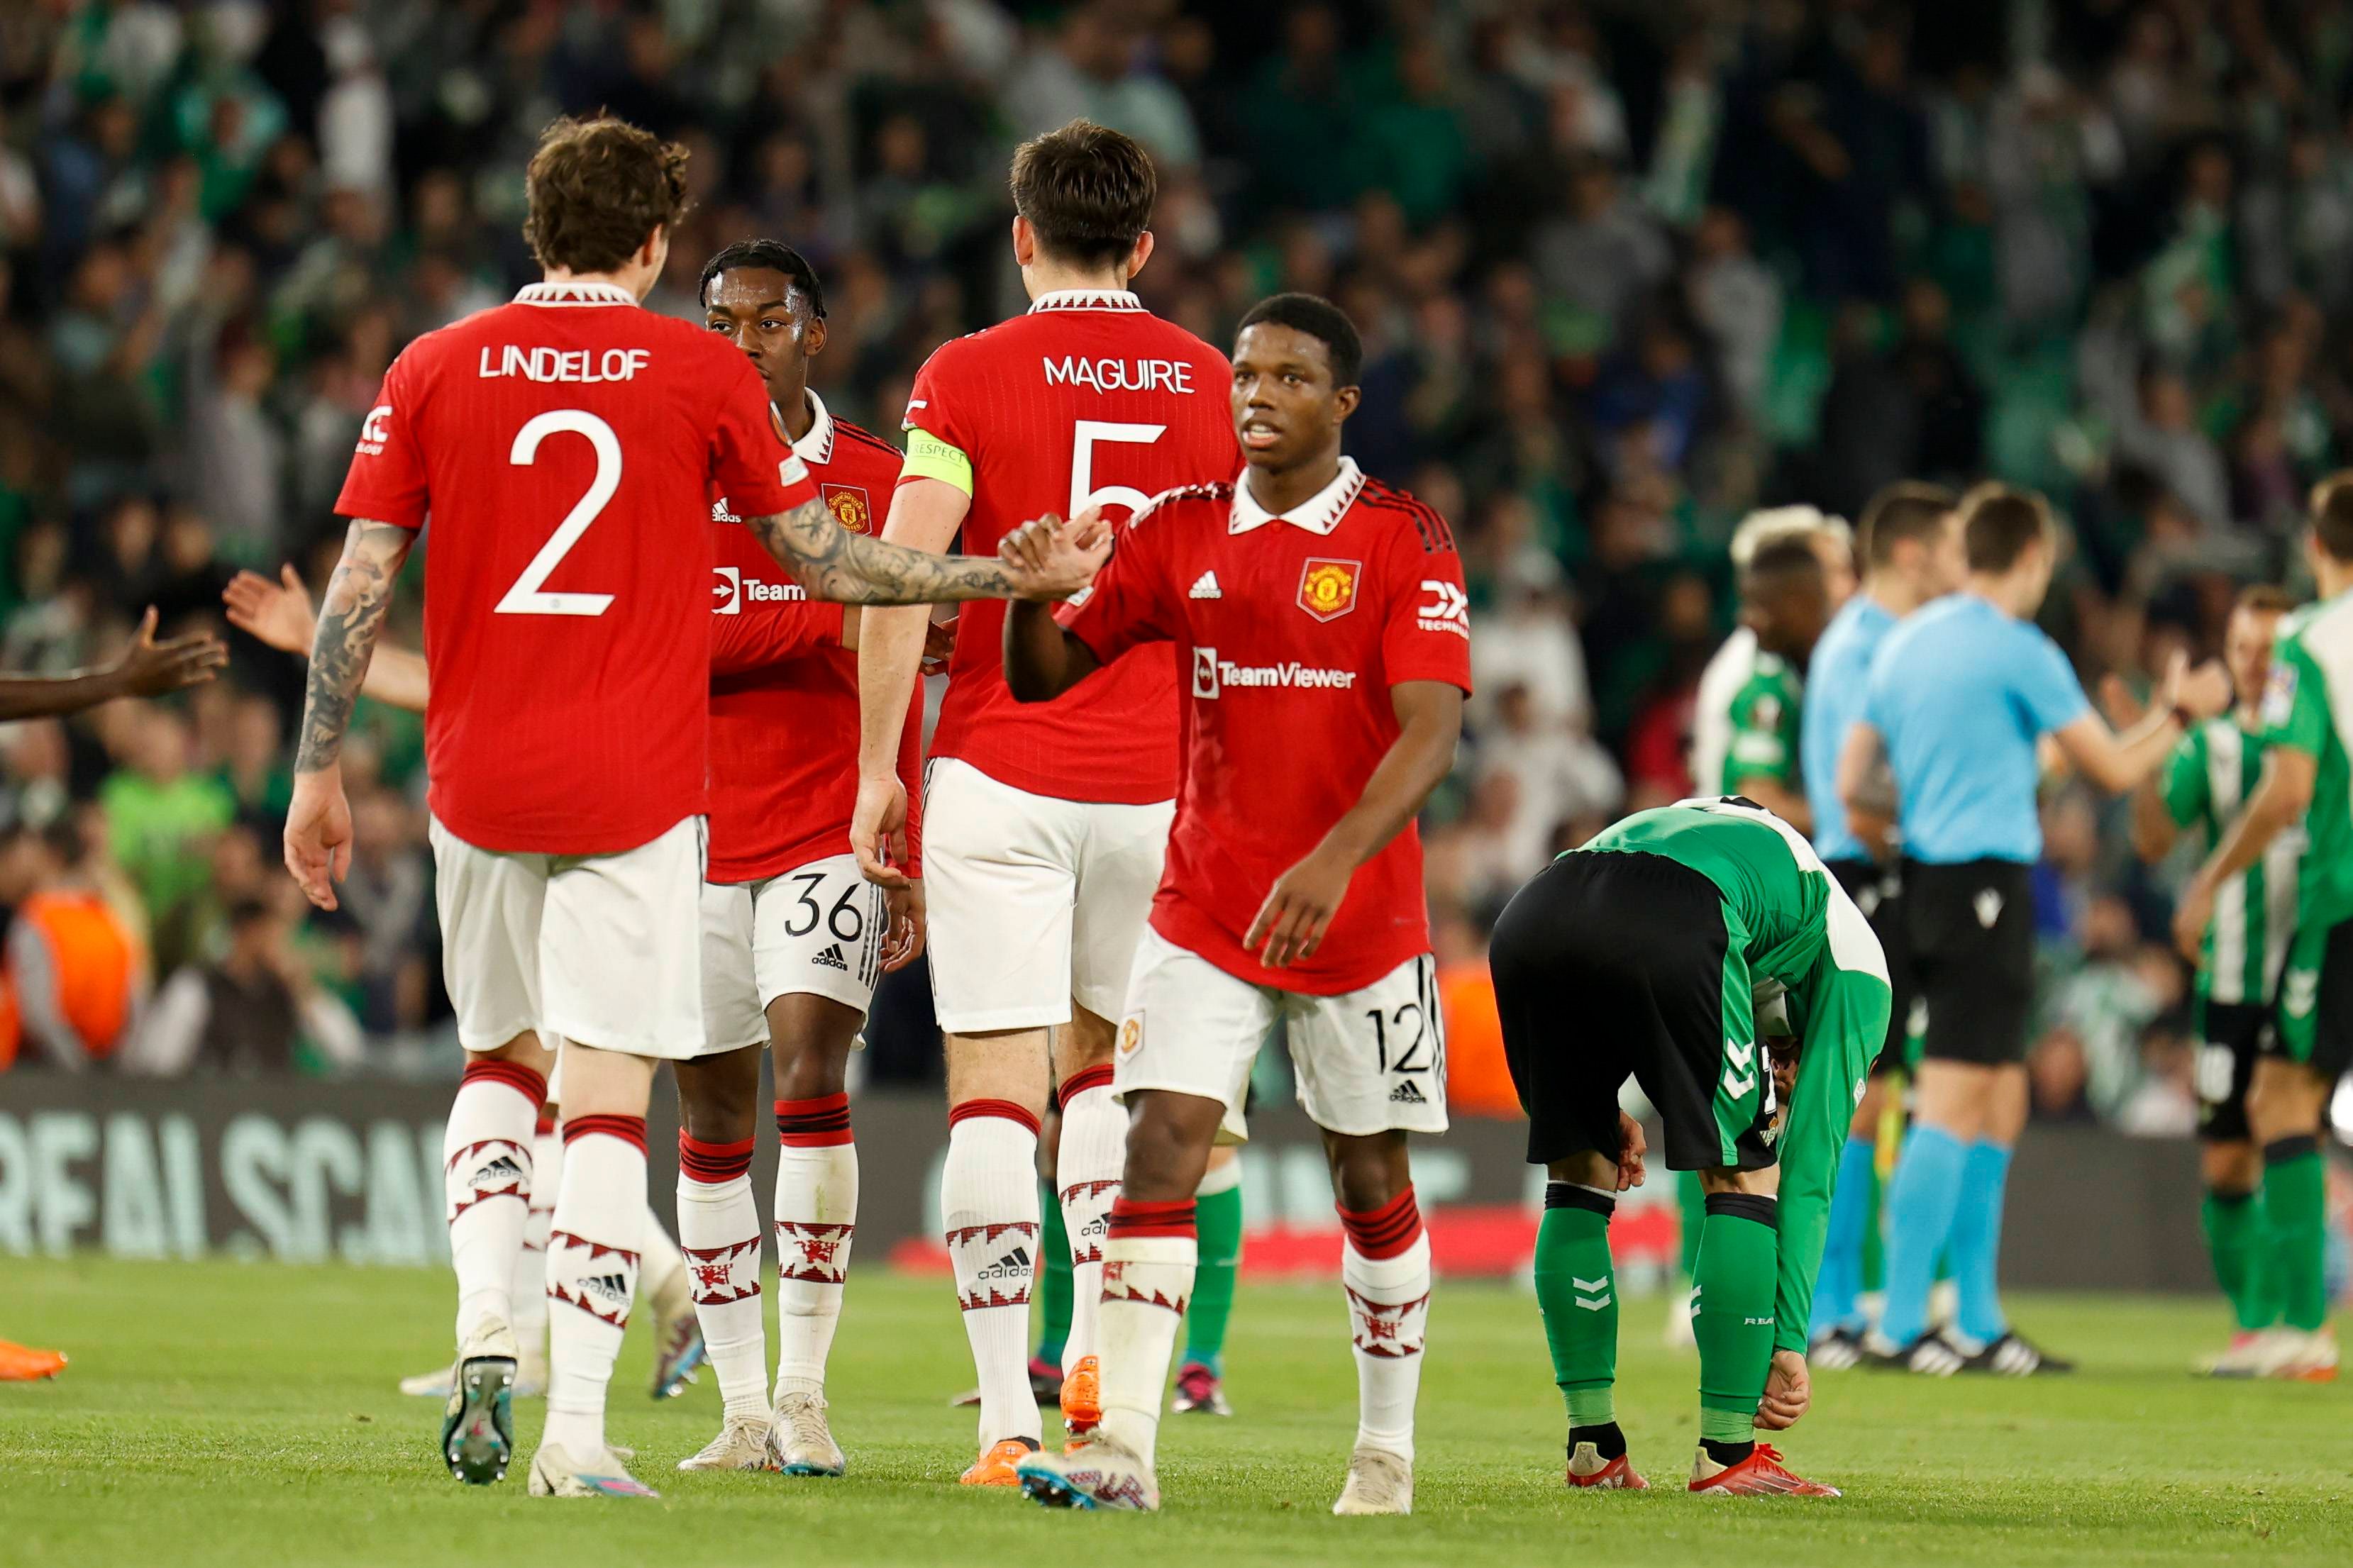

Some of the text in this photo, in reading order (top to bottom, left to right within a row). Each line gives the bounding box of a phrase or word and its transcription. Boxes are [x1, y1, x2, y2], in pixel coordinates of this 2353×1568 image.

[480, 345, 650, 383] LINDELOF
[1043, 355, 1195, 395] MAGUIRE
[914, 444, 966, 463] RESPECT
[494, 409, 622, 616] 2
[1217, 661, 1356, 689] TeamViewer
[785, 873, 863, 943] 36
[812, 957, 848, 971] adidas
[1366, 1003, 1430, 1075] 12
[978, 1264, 1034, 1280] adidas
[1744, 1316, 1774, 1325] REA
